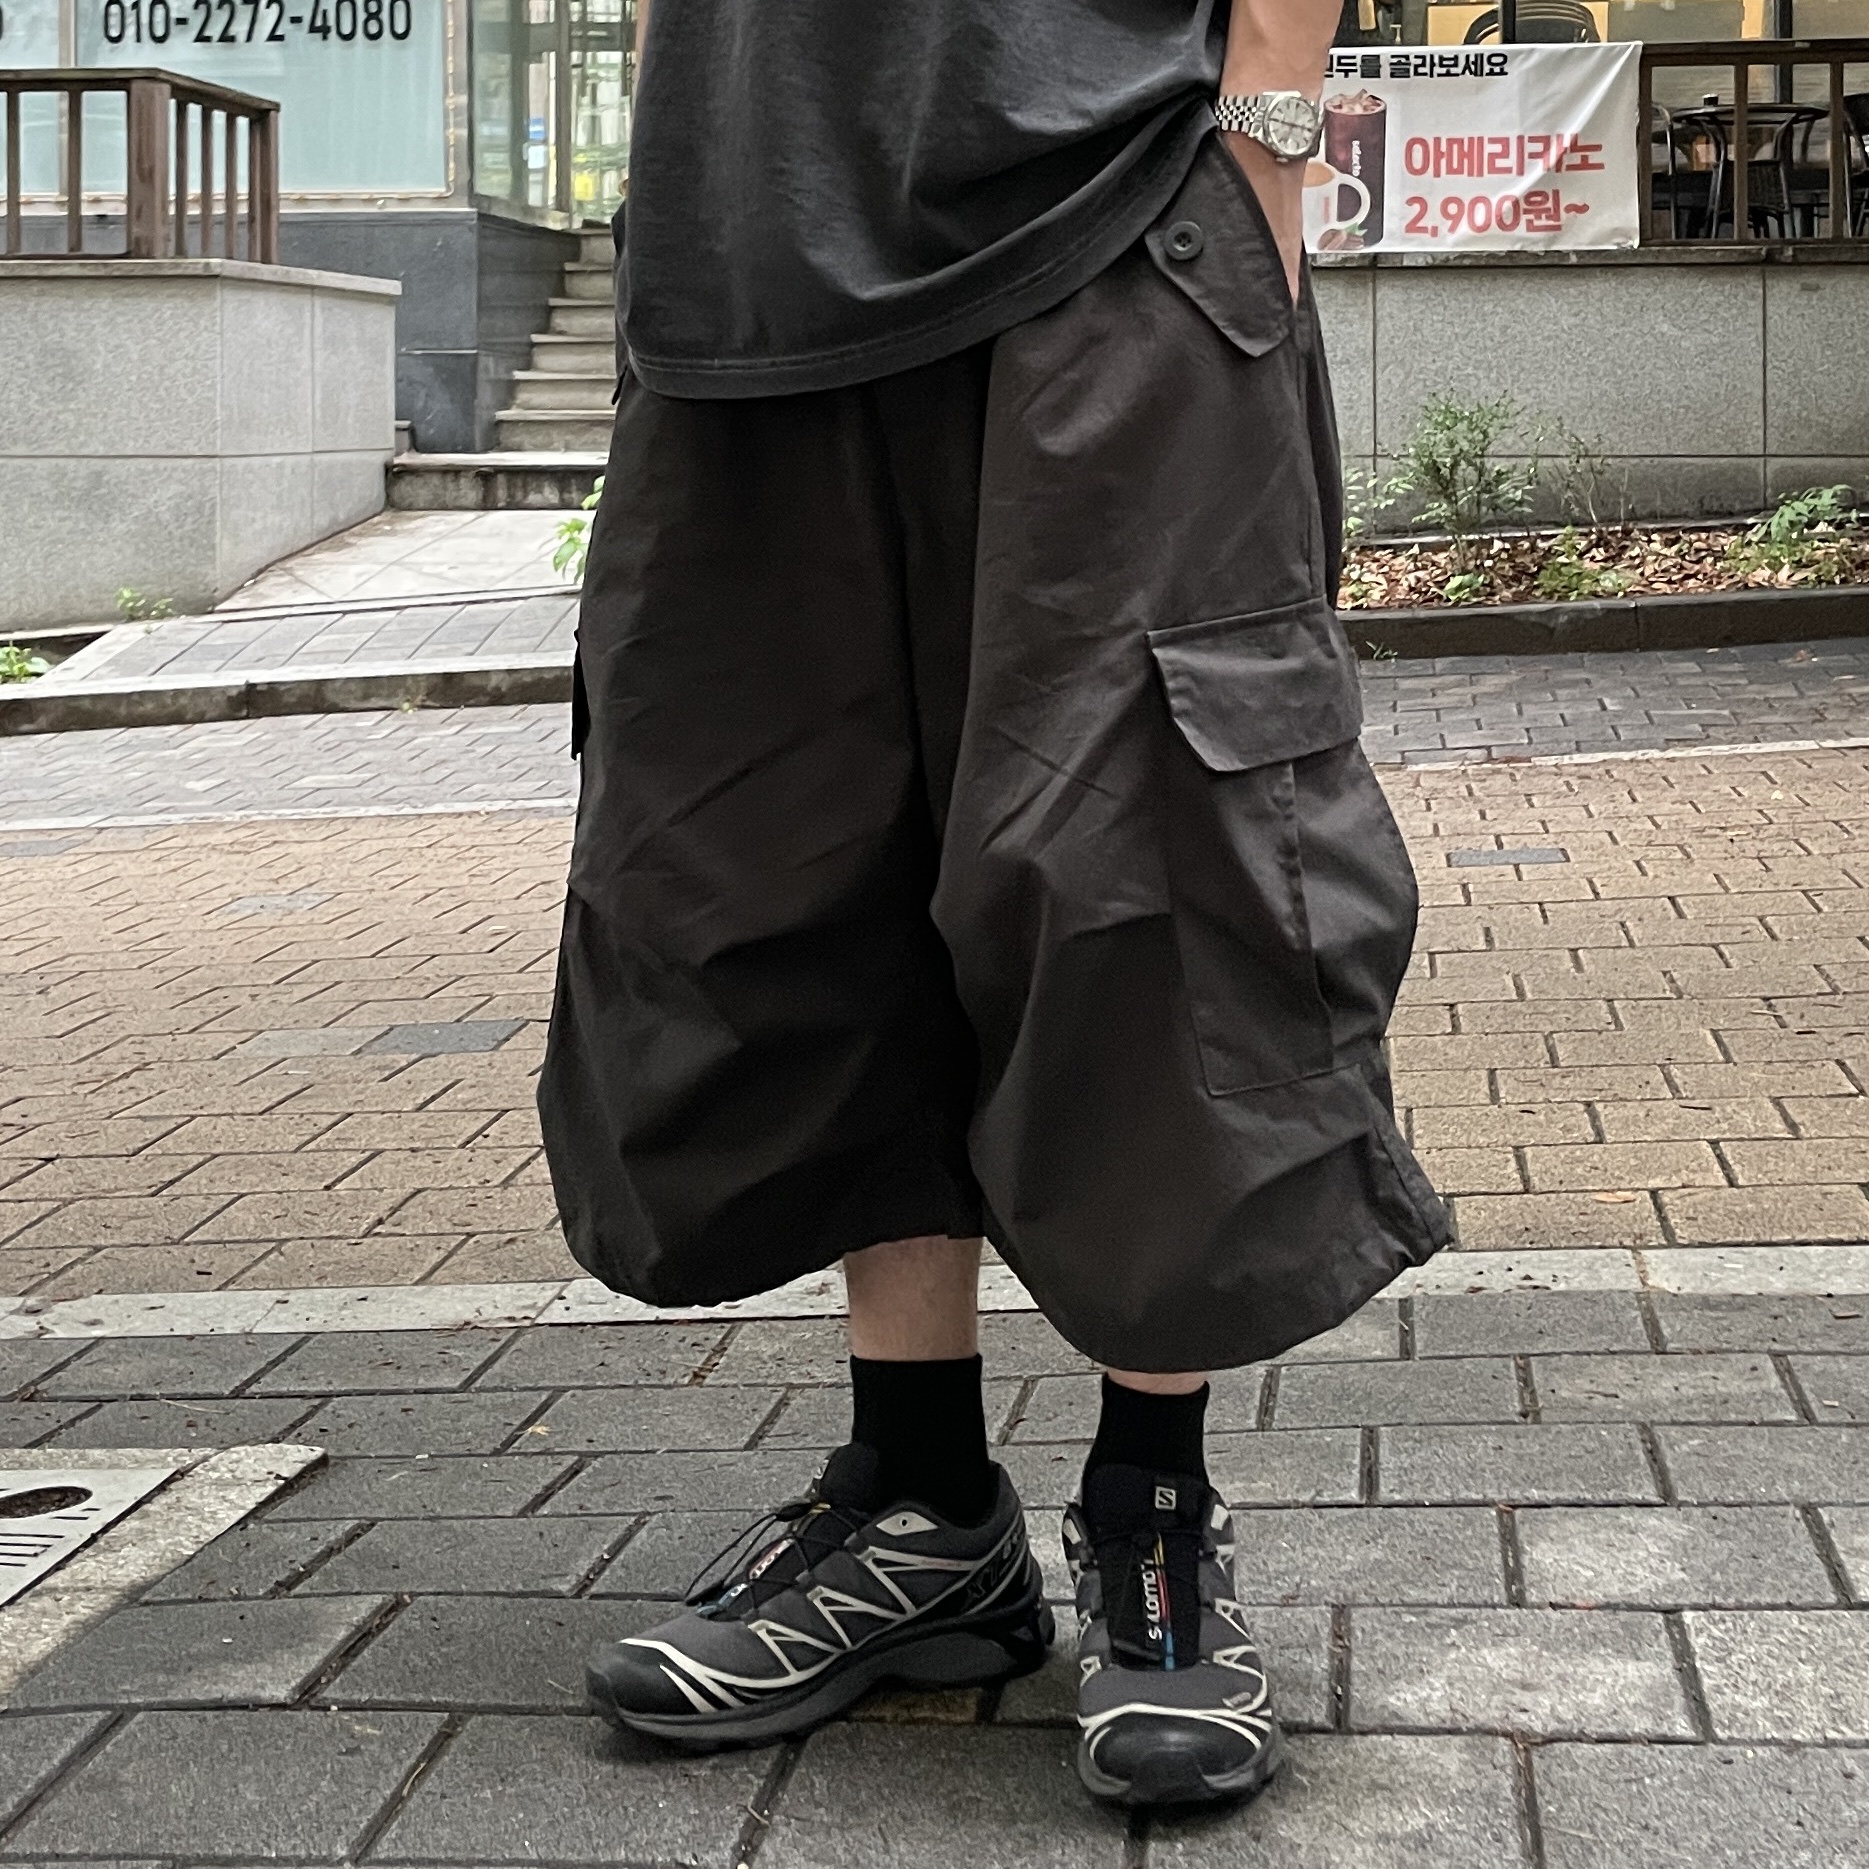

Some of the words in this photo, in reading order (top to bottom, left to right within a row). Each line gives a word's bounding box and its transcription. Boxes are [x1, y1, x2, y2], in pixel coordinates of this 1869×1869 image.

[103, 0, 411, 44] 010-2272-4080
[1389, 53, 1509, 78] 골라보세요
[1404, 133, 1605, 178] 아메리카노
[1404, 189, 1590, 237] 2,900원~
